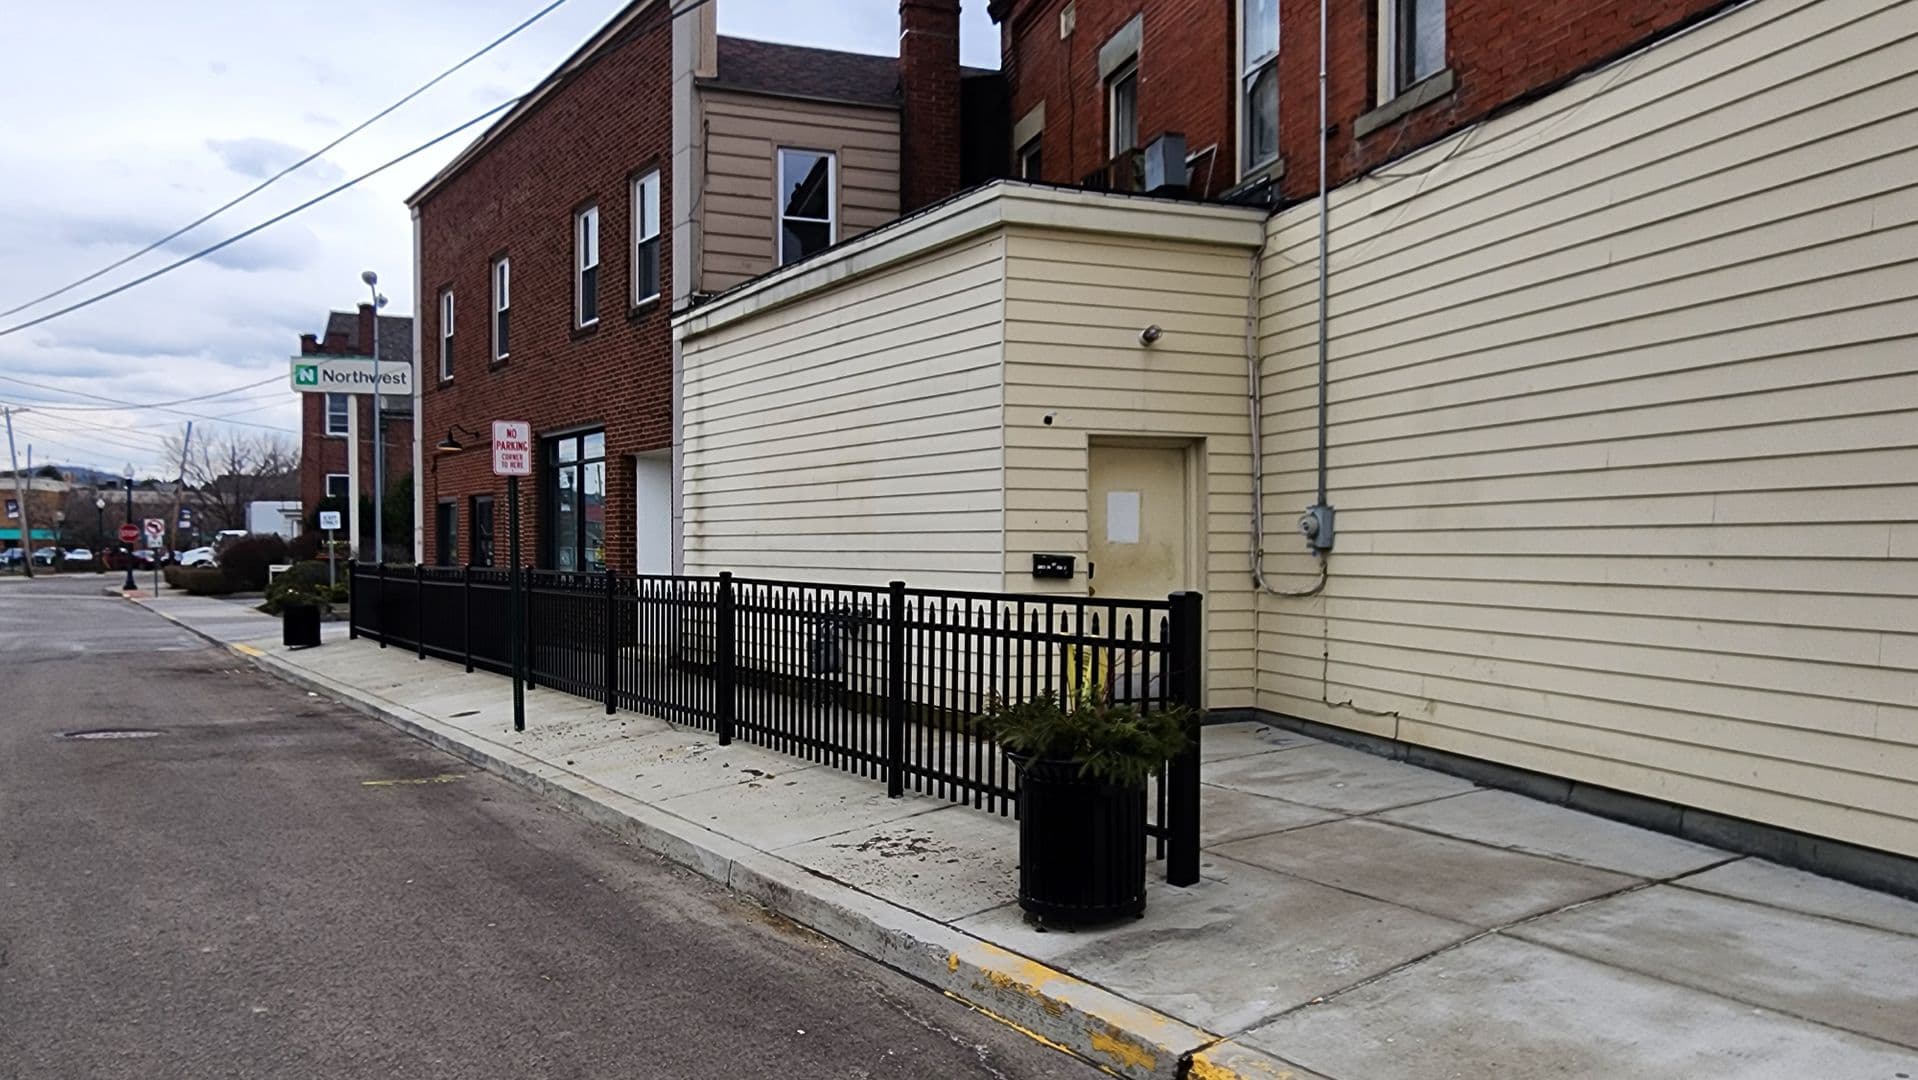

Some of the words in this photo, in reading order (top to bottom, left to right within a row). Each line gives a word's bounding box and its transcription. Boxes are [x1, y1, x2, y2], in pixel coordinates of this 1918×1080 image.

[322, 369, 407, 385] Northwest
[506, 428, 517, 439] NO
[496, 440, 528, 452] PARKING
[501, 453, 523, 461] CORNER
[510, 461, 523, 469] HERE
